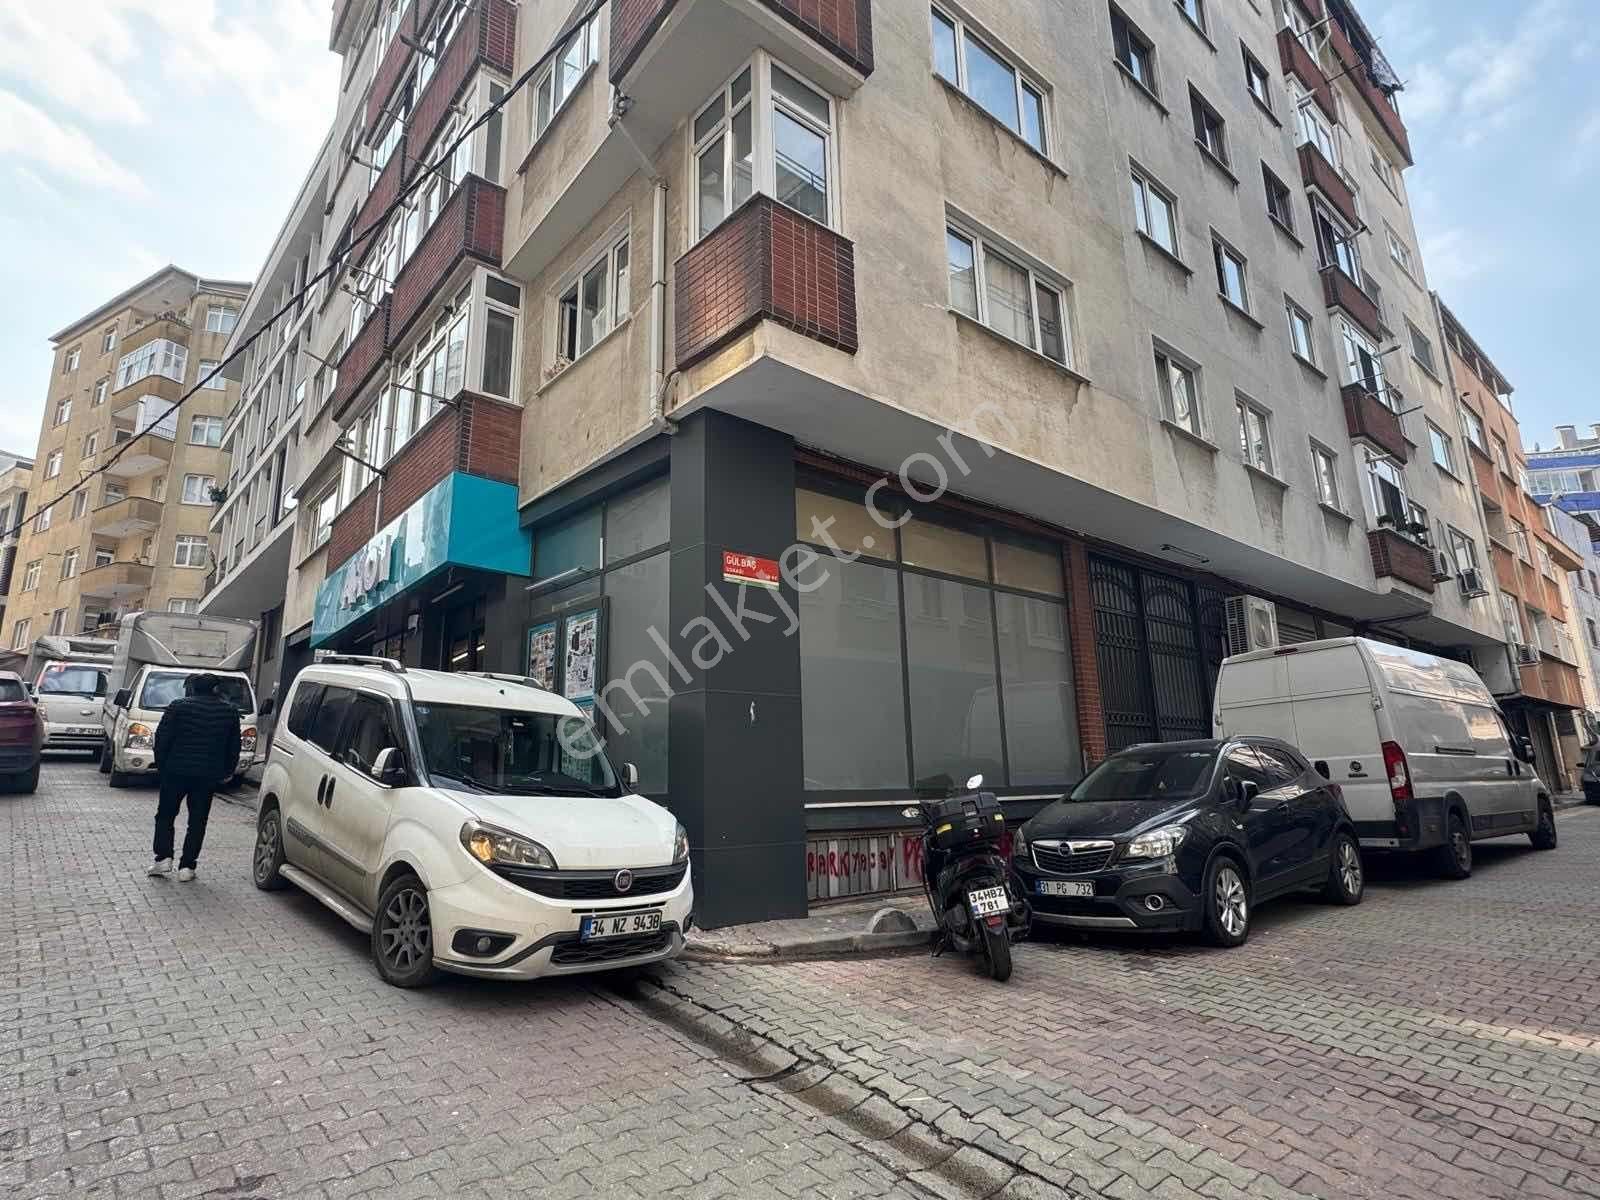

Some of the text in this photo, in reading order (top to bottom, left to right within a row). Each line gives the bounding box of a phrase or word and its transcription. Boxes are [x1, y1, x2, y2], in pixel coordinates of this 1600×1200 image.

[726, 555, 757, 570] GÜLBAŞ
[969, 887, 1005, 904] 34HBZ
[1075, 883, 1092, 895] 732
[591, 914, 660, 936] 34 NZ 9438
